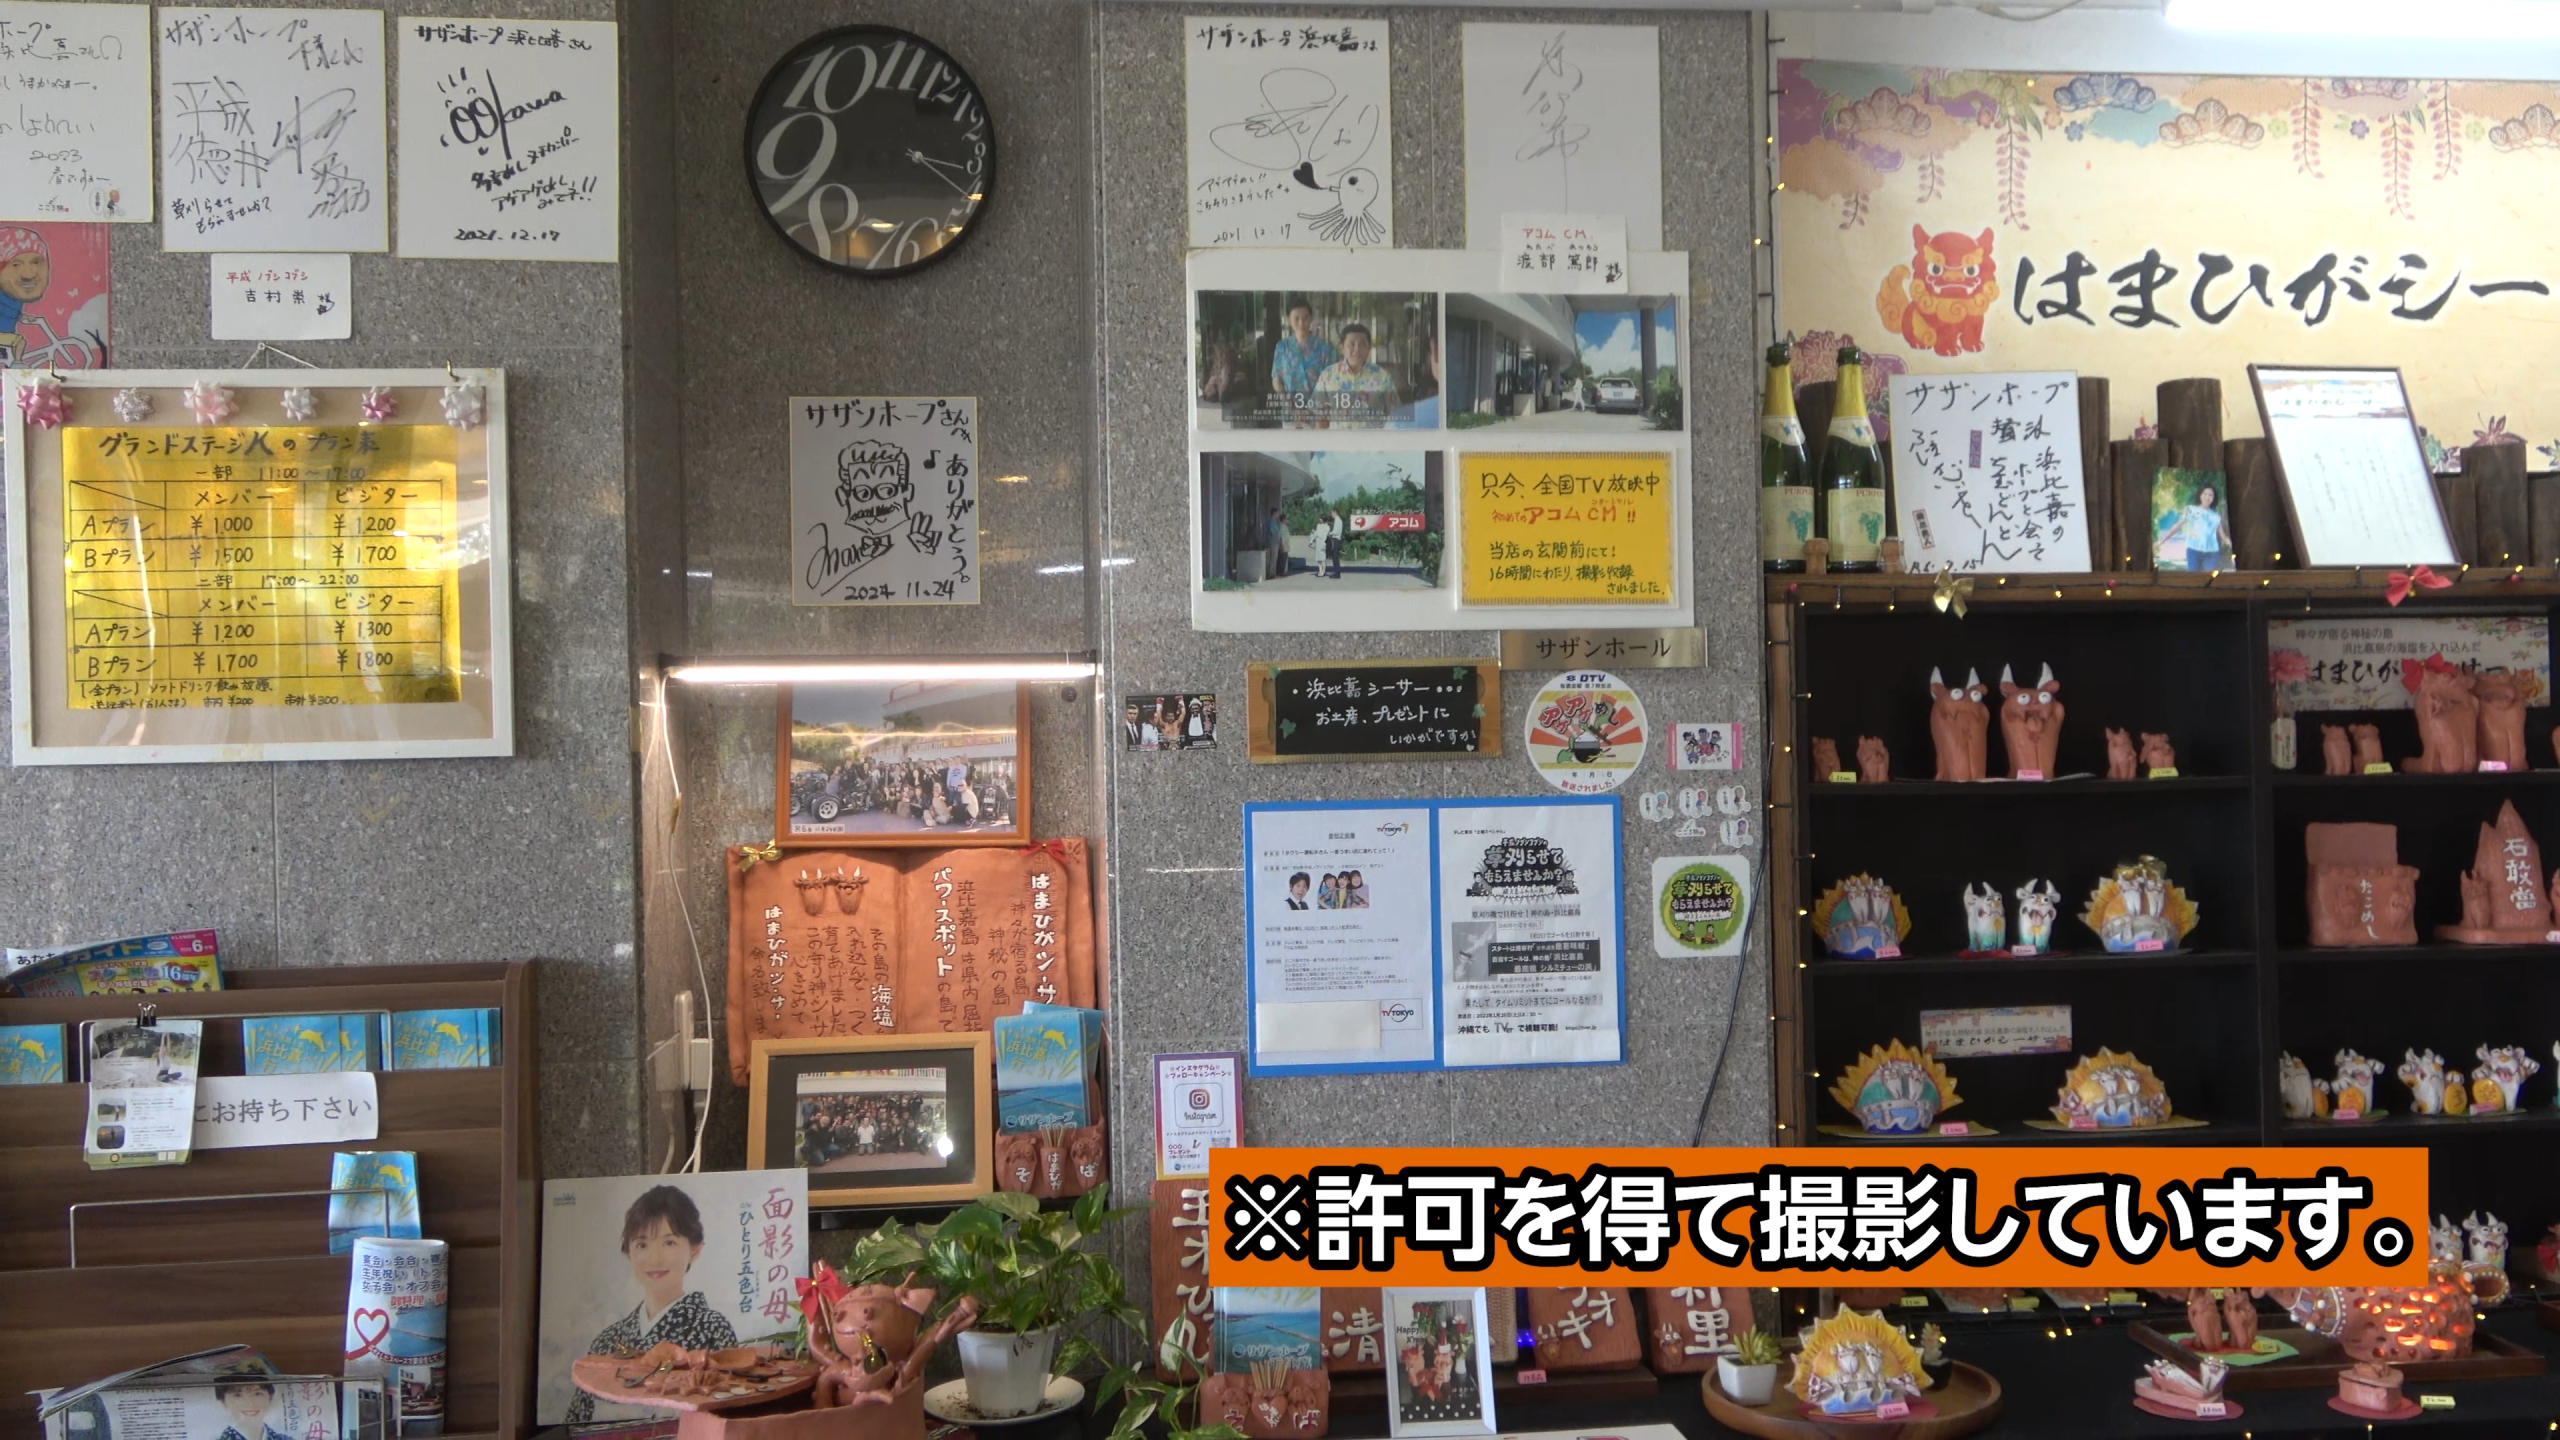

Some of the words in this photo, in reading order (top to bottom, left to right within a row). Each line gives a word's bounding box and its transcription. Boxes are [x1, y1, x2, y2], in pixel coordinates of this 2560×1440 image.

[783, 45, 877, 113] 10
[875, 40, 926, 90] 11
[918, 61, 961, 103] 12
[961, 106, 984, 141] 2
[756, 112, 837, 215] 9
[966, 141, 986, 174] 3
[787, 183, 858, 260] 8
[2012, 248, 2551, 329] はまひがシー
[196, 466, 233, 481] 一部
[194, 489, 275, 507] メンバー
[335, 489, 419, 505] ビジター
[1388, 517, 1420, 529] アコム
[200, 597, 277, 613] メンバー
[335, 595, 415, 610] ビジター
[1535, 637, 1672, 660] サザンホール
[1183, 1112, 1217, 1123] Instagram
[1016, 1167, 1030, 1183] そ
[1079, 1164, 1098, 1177] ば
[737, 1210, 755, 1314] ひとり五色台
[757, 1187, 795, 1325] 面影の母
